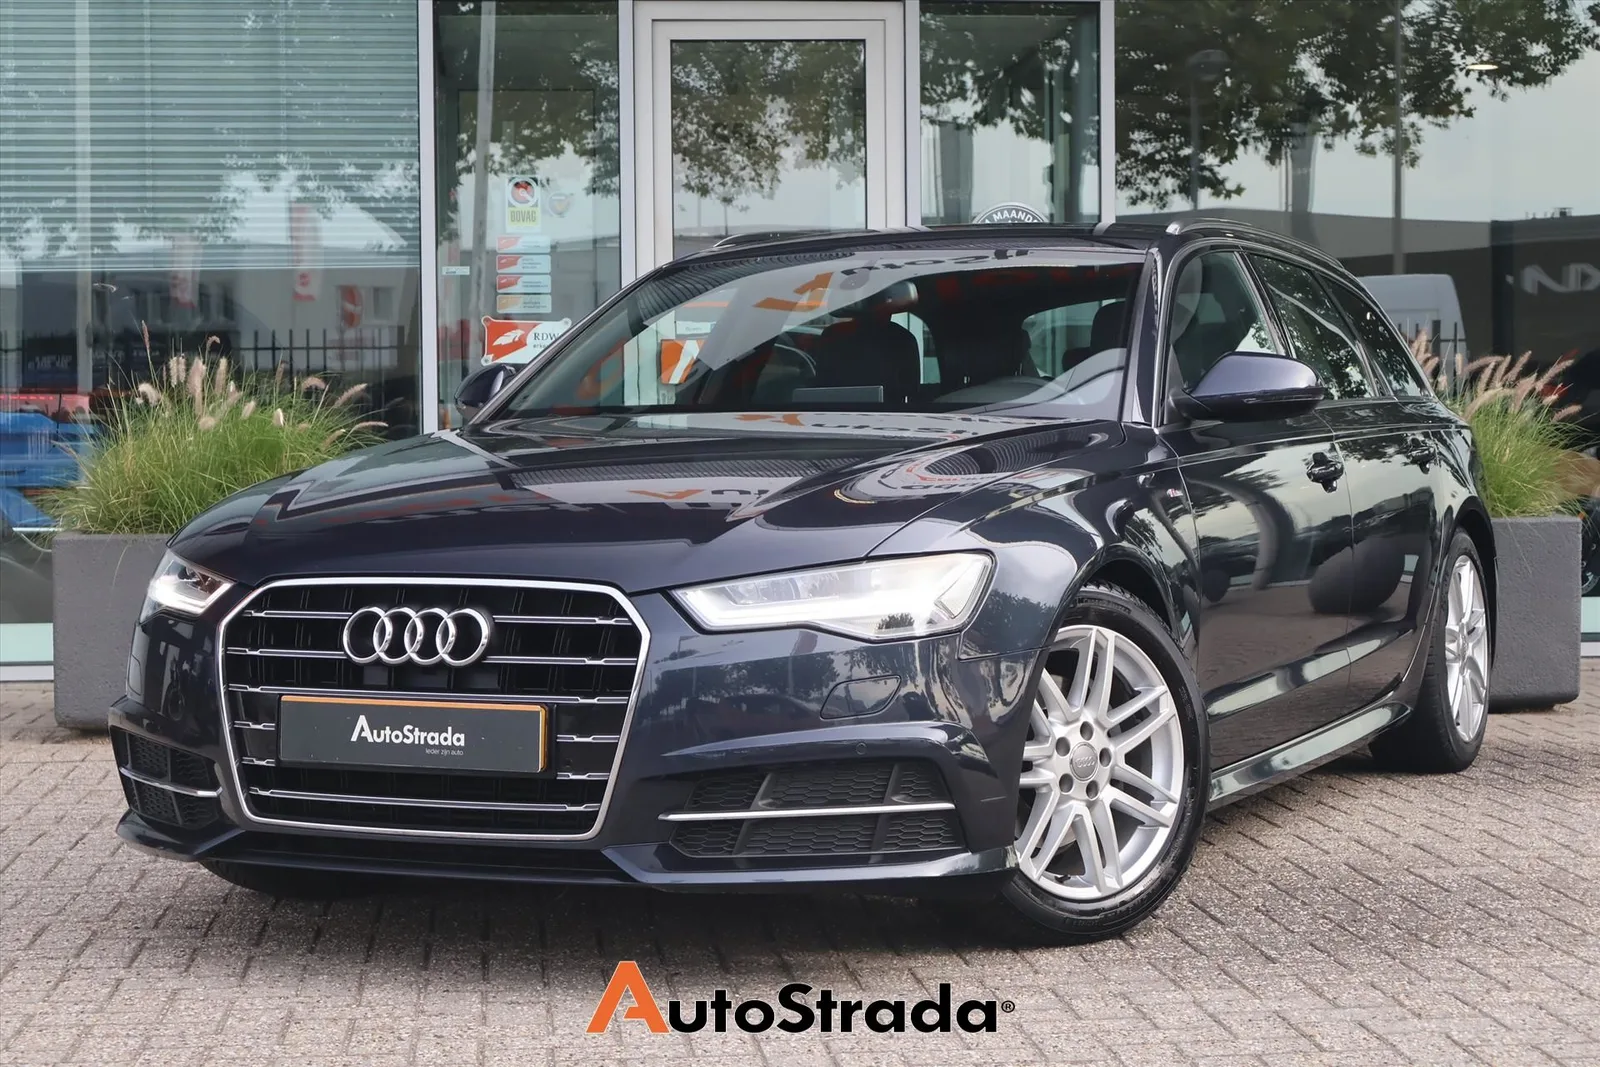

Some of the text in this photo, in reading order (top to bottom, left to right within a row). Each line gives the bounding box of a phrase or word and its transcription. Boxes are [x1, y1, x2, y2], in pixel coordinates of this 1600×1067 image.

[510, 210, 537, 222] BOVAG
[533, 332, 560, 341] RDW
[350, 714, 465, 747] AutoStrada
